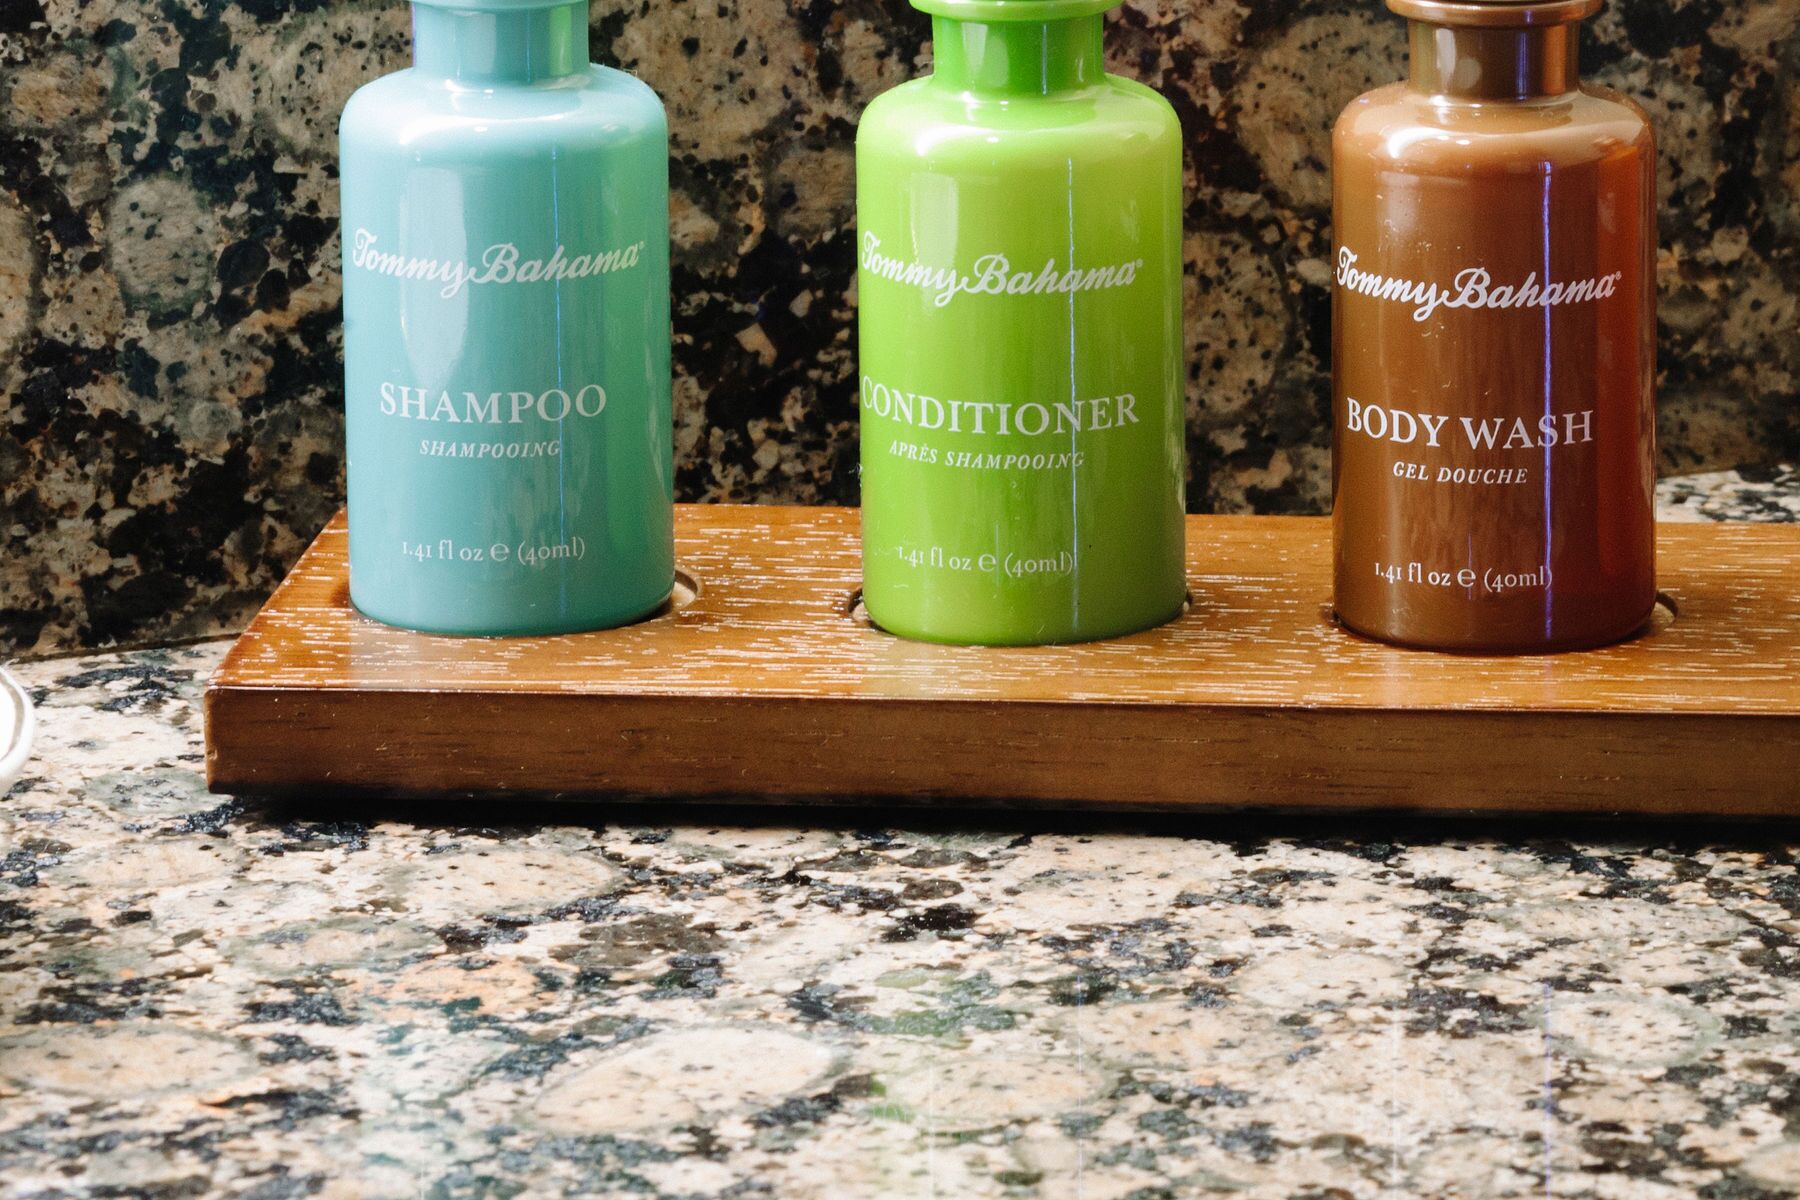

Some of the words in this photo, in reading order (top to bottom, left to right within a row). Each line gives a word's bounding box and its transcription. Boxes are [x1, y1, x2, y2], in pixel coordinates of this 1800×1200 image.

[352, 228, 469, 299] Tommy
[861, 230, 966, 308] Tommy
[1336, 246, 1445, 322] Tommy
[380, 382, 607, 424] SHAMPOO
[862, 376, 1139, 436] CONDITIONER
[1347, 398, 1448, 447] BODY
[1459, 410, 1594, 450] WASH
[419, 439, 561, 459] SHAMPOOING
[944, 451, 1084, 470] SHAMPOOING
[1392, 461, 1429, 481] GEL
[1437, 467, 1528, 484] DOUCHE
[402, 541, 432, 559] 1.41
[438, 539, 454, 559] fl
[459, 546, 483, 561] oz
[518, 537, 586, 566] (40ml)
[895, 546, 924, 567] 1.41
[930, 546, 944, 568] fl
[950, 557, 972, 571] oz
[1004, 551, 1073, 578] (40ml)
[1374, 562, 1402, 583] 1.41
[1408, 562, 1422, 583] fl
[1428, 571, 1451, 586] oz
[1484, 565, 1553, 592] (40ml)
